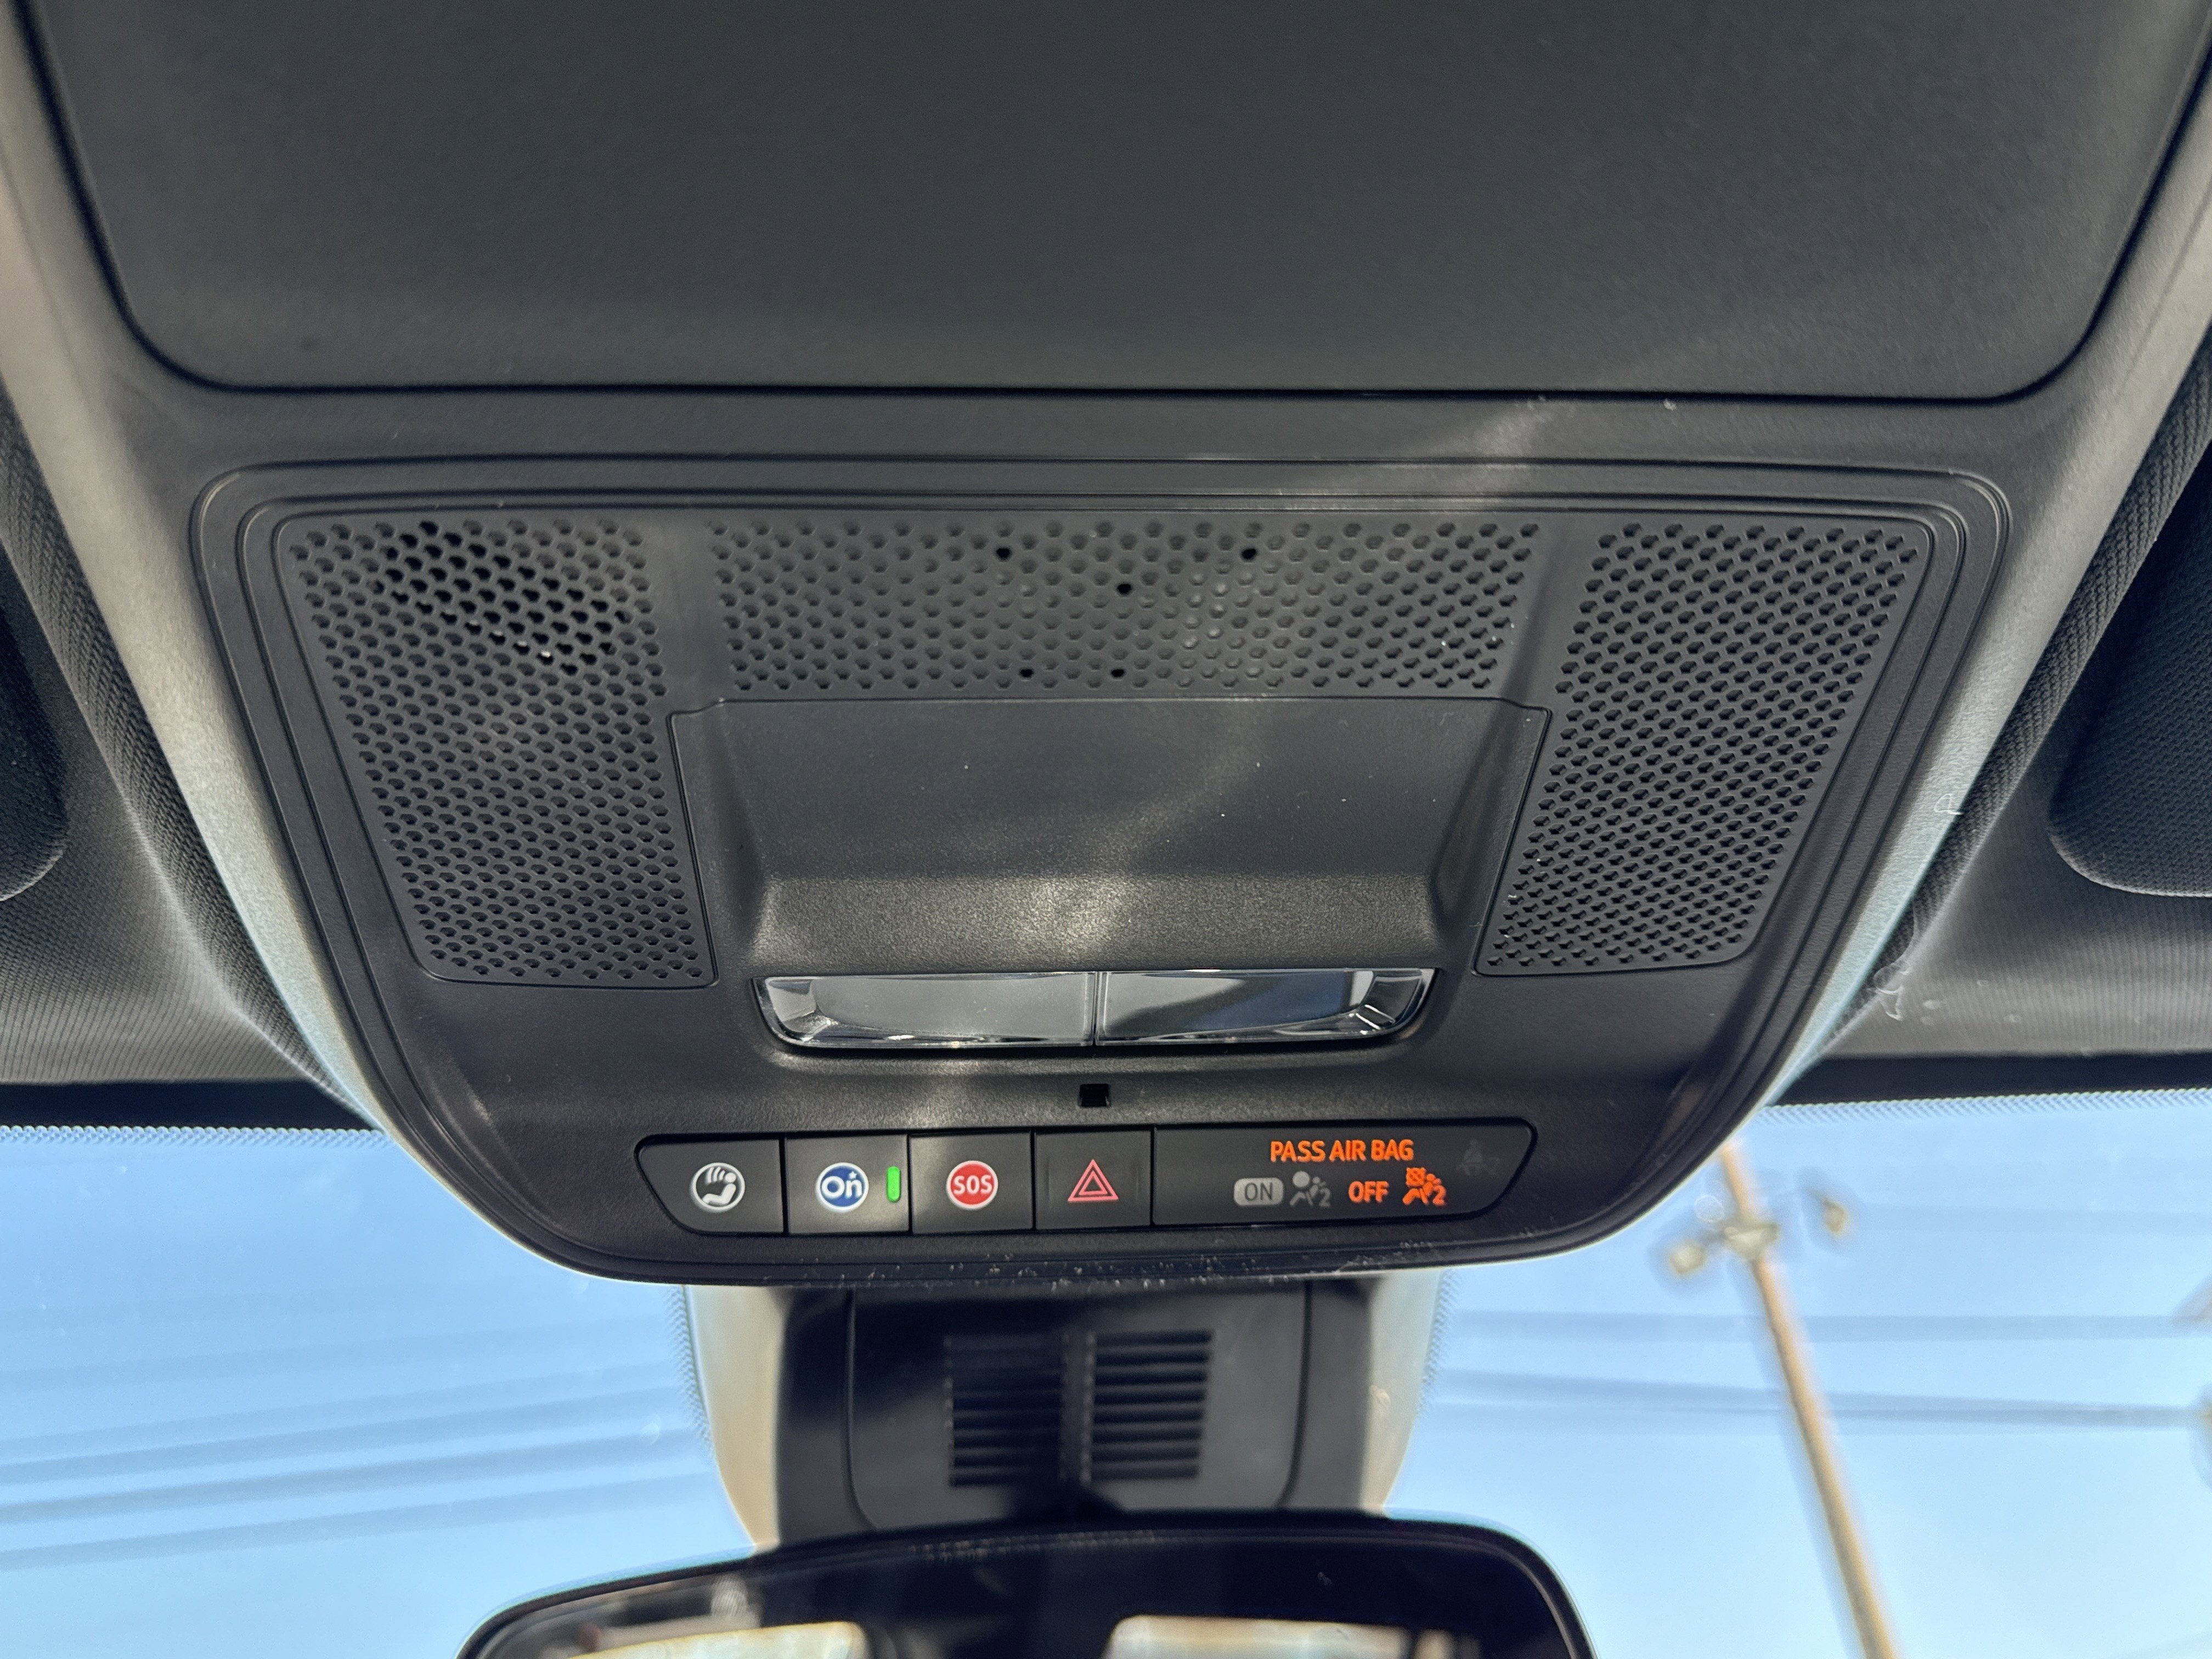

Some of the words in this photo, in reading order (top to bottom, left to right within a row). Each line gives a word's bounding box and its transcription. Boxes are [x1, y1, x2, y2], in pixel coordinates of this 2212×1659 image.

[1270, 1140, 1326, 1163] PASS
[1329, 1139, 1367, 1162] AIR
[1371, 1139, 1414, 1161] BAG
[823, 1173, 862, 1199] On
[953, 1175, 992, 1194] SOS
[1244, 1182, 1273, 1201] ON
[1348, 1181, 1389, 1203] OFF
